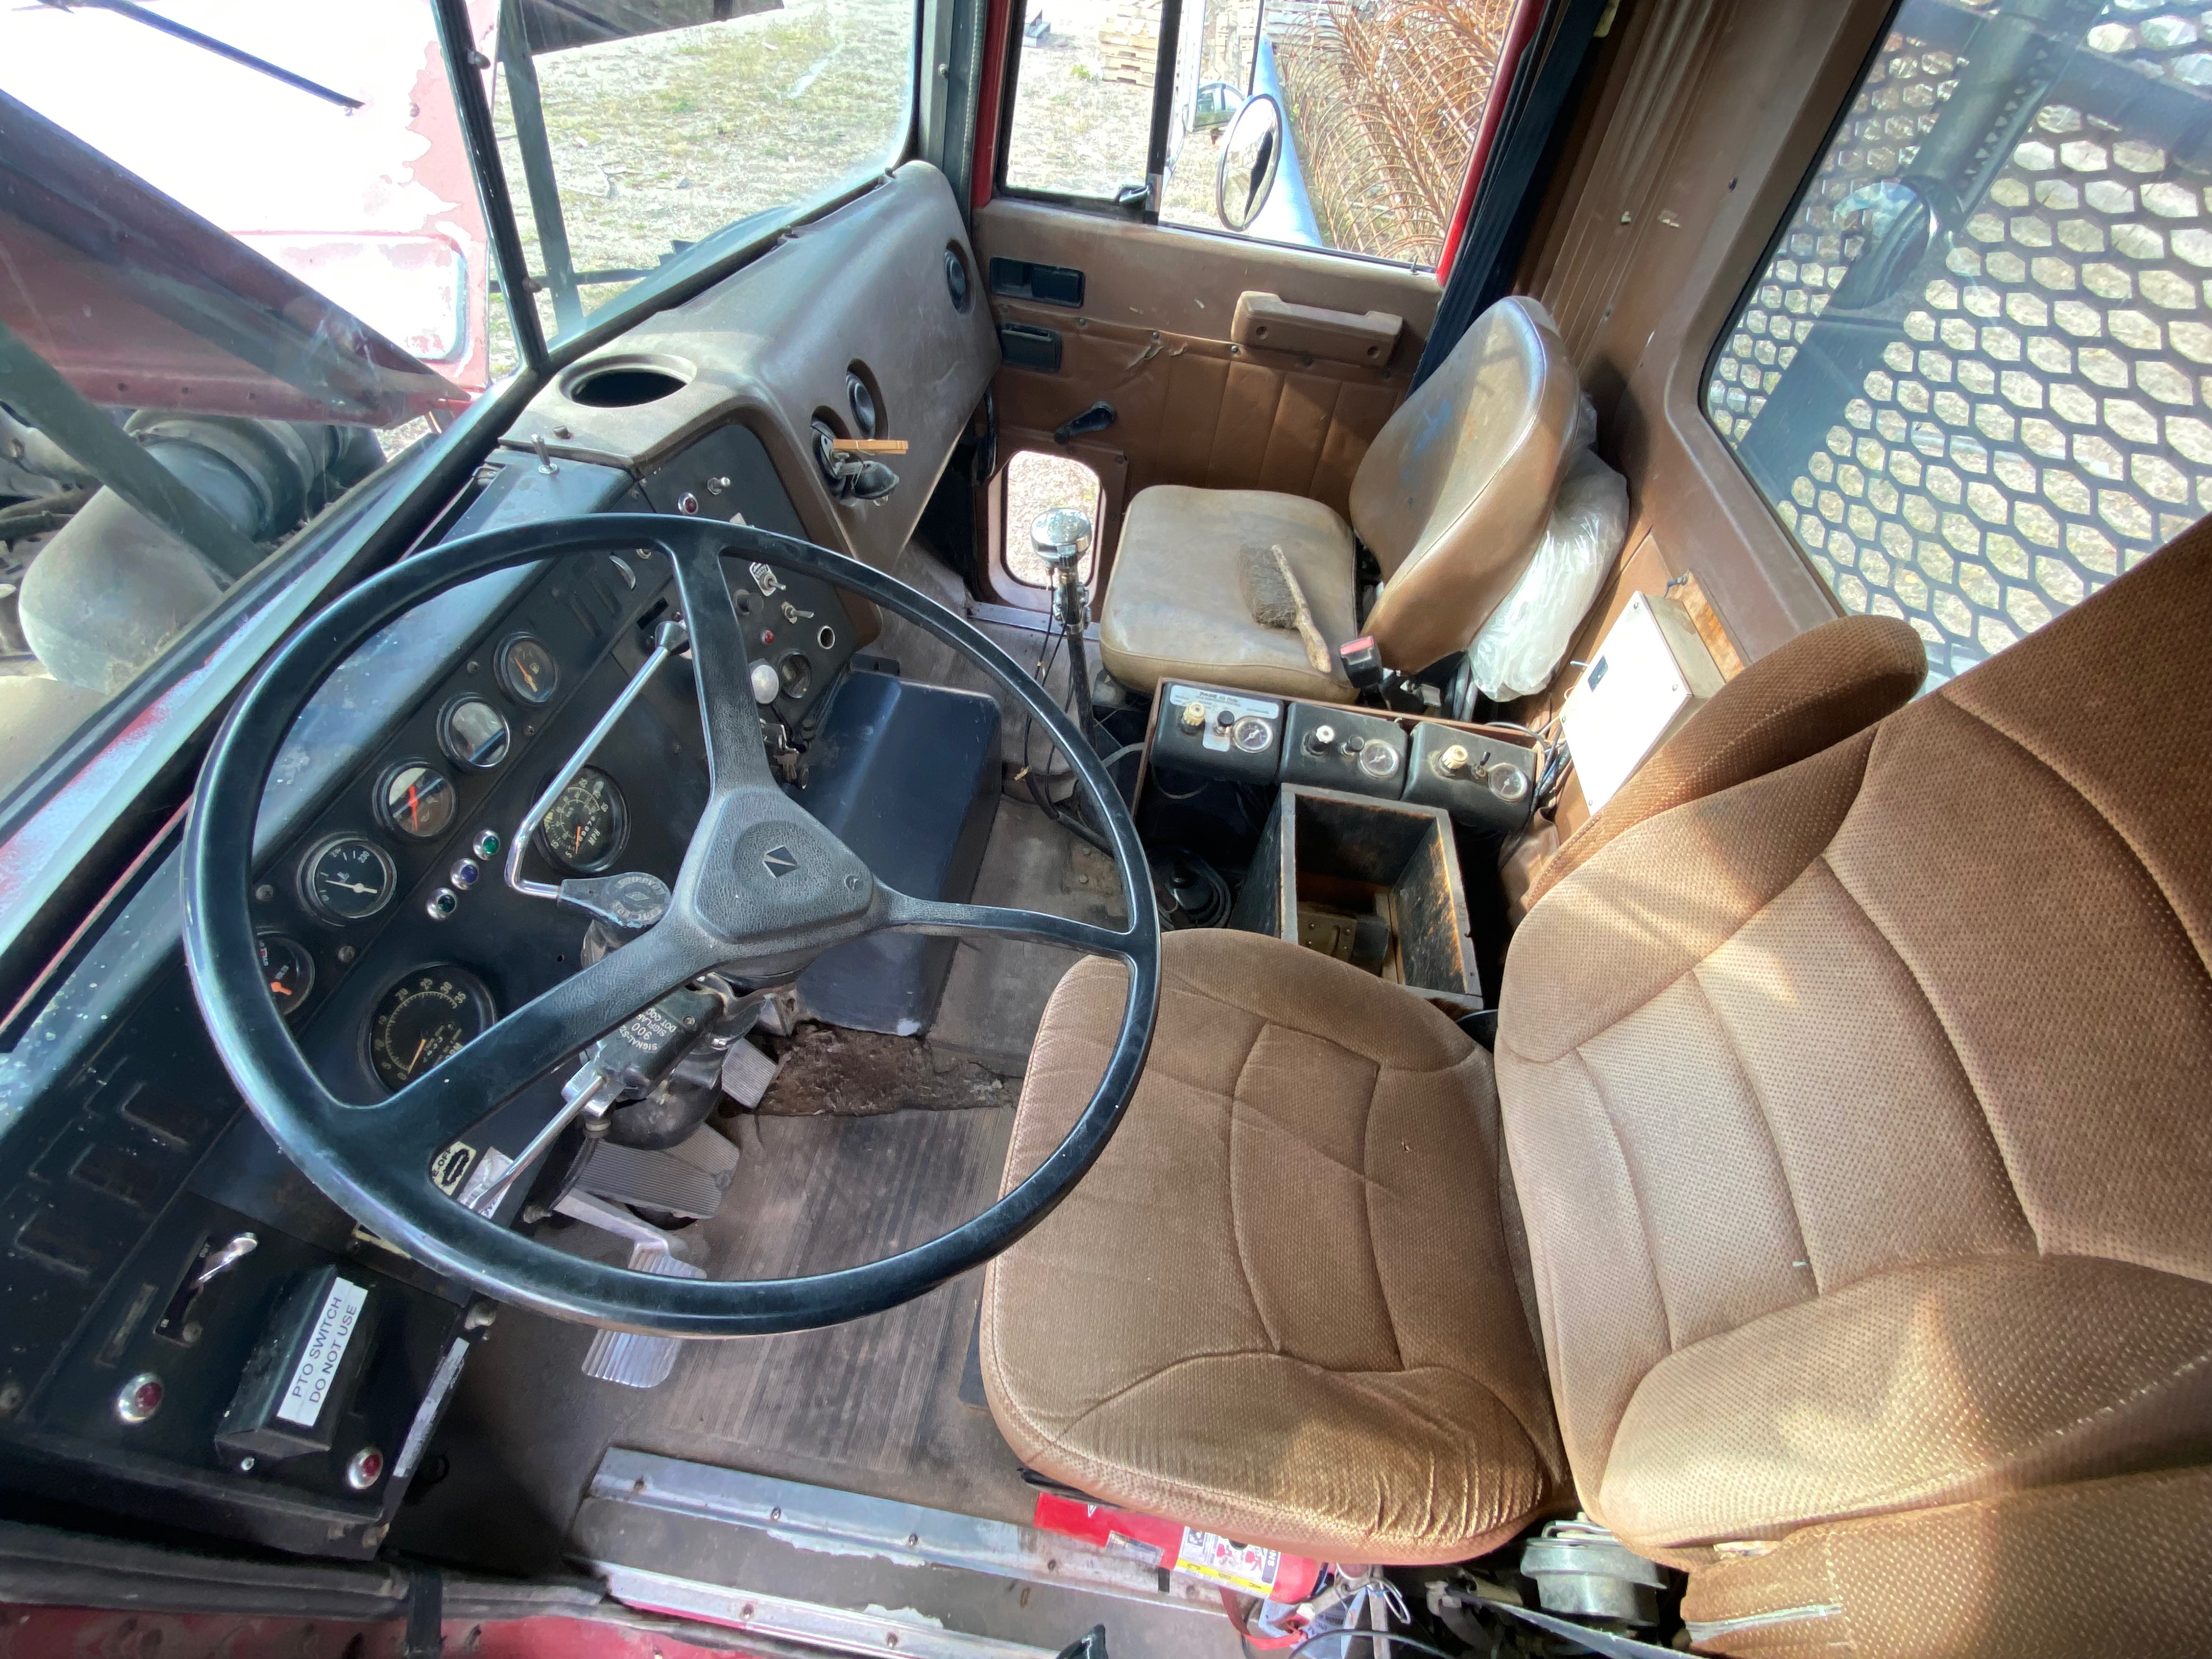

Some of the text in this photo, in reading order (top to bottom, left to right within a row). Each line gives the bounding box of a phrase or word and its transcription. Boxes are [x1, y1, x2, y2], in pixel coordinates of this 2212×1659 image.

[579, 777, 588, 788] 65
[600, 802, 609, 812] 85
[550, 839, 560, 849] 15
[588, 828, 601, 846] MPH
[357, 850, 370, 864] 230
[565, 850, 573, 859] 5
[440, 981, 452, 995] 30
[455, 991, 466, 1004] 35
[631, 1023, 652, 1040] 900
[661, 1019, 676, 1033] DOT
[432, 1147, 452, 1180] E-OFF
[292, 1297, 342, 1398] PTO SWITCH
[309, 1305, 357, 1403] DO NOT USE
